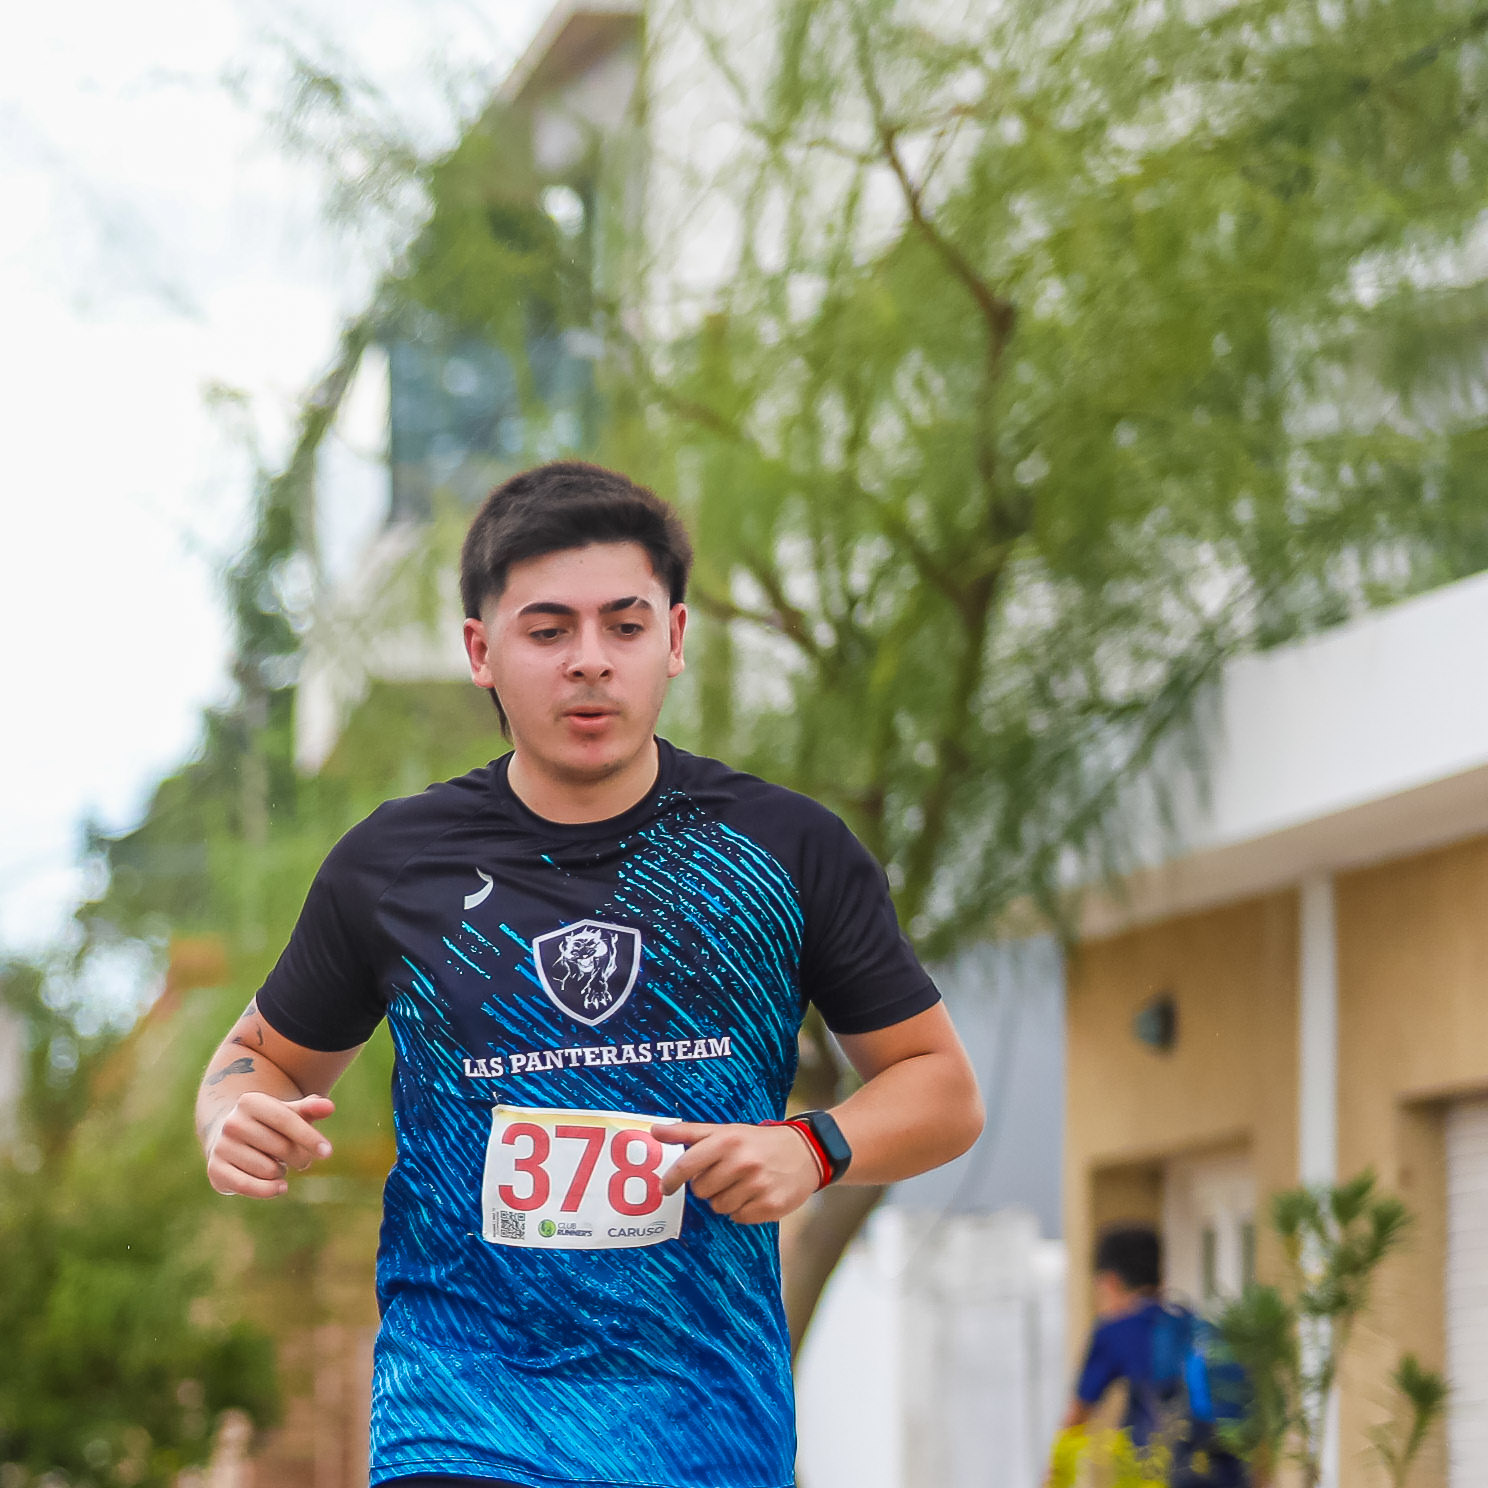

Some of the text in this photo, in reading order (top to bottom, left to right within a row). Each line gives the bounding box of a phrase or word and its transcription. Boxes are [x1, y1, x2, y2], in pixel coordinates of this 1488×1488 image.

[462, 1036, 732, 1078] LAS PANTERAS TEAM
[498, 1122, 664, 1217] 378
[607, 1226, 665, 1238] CARUSO
